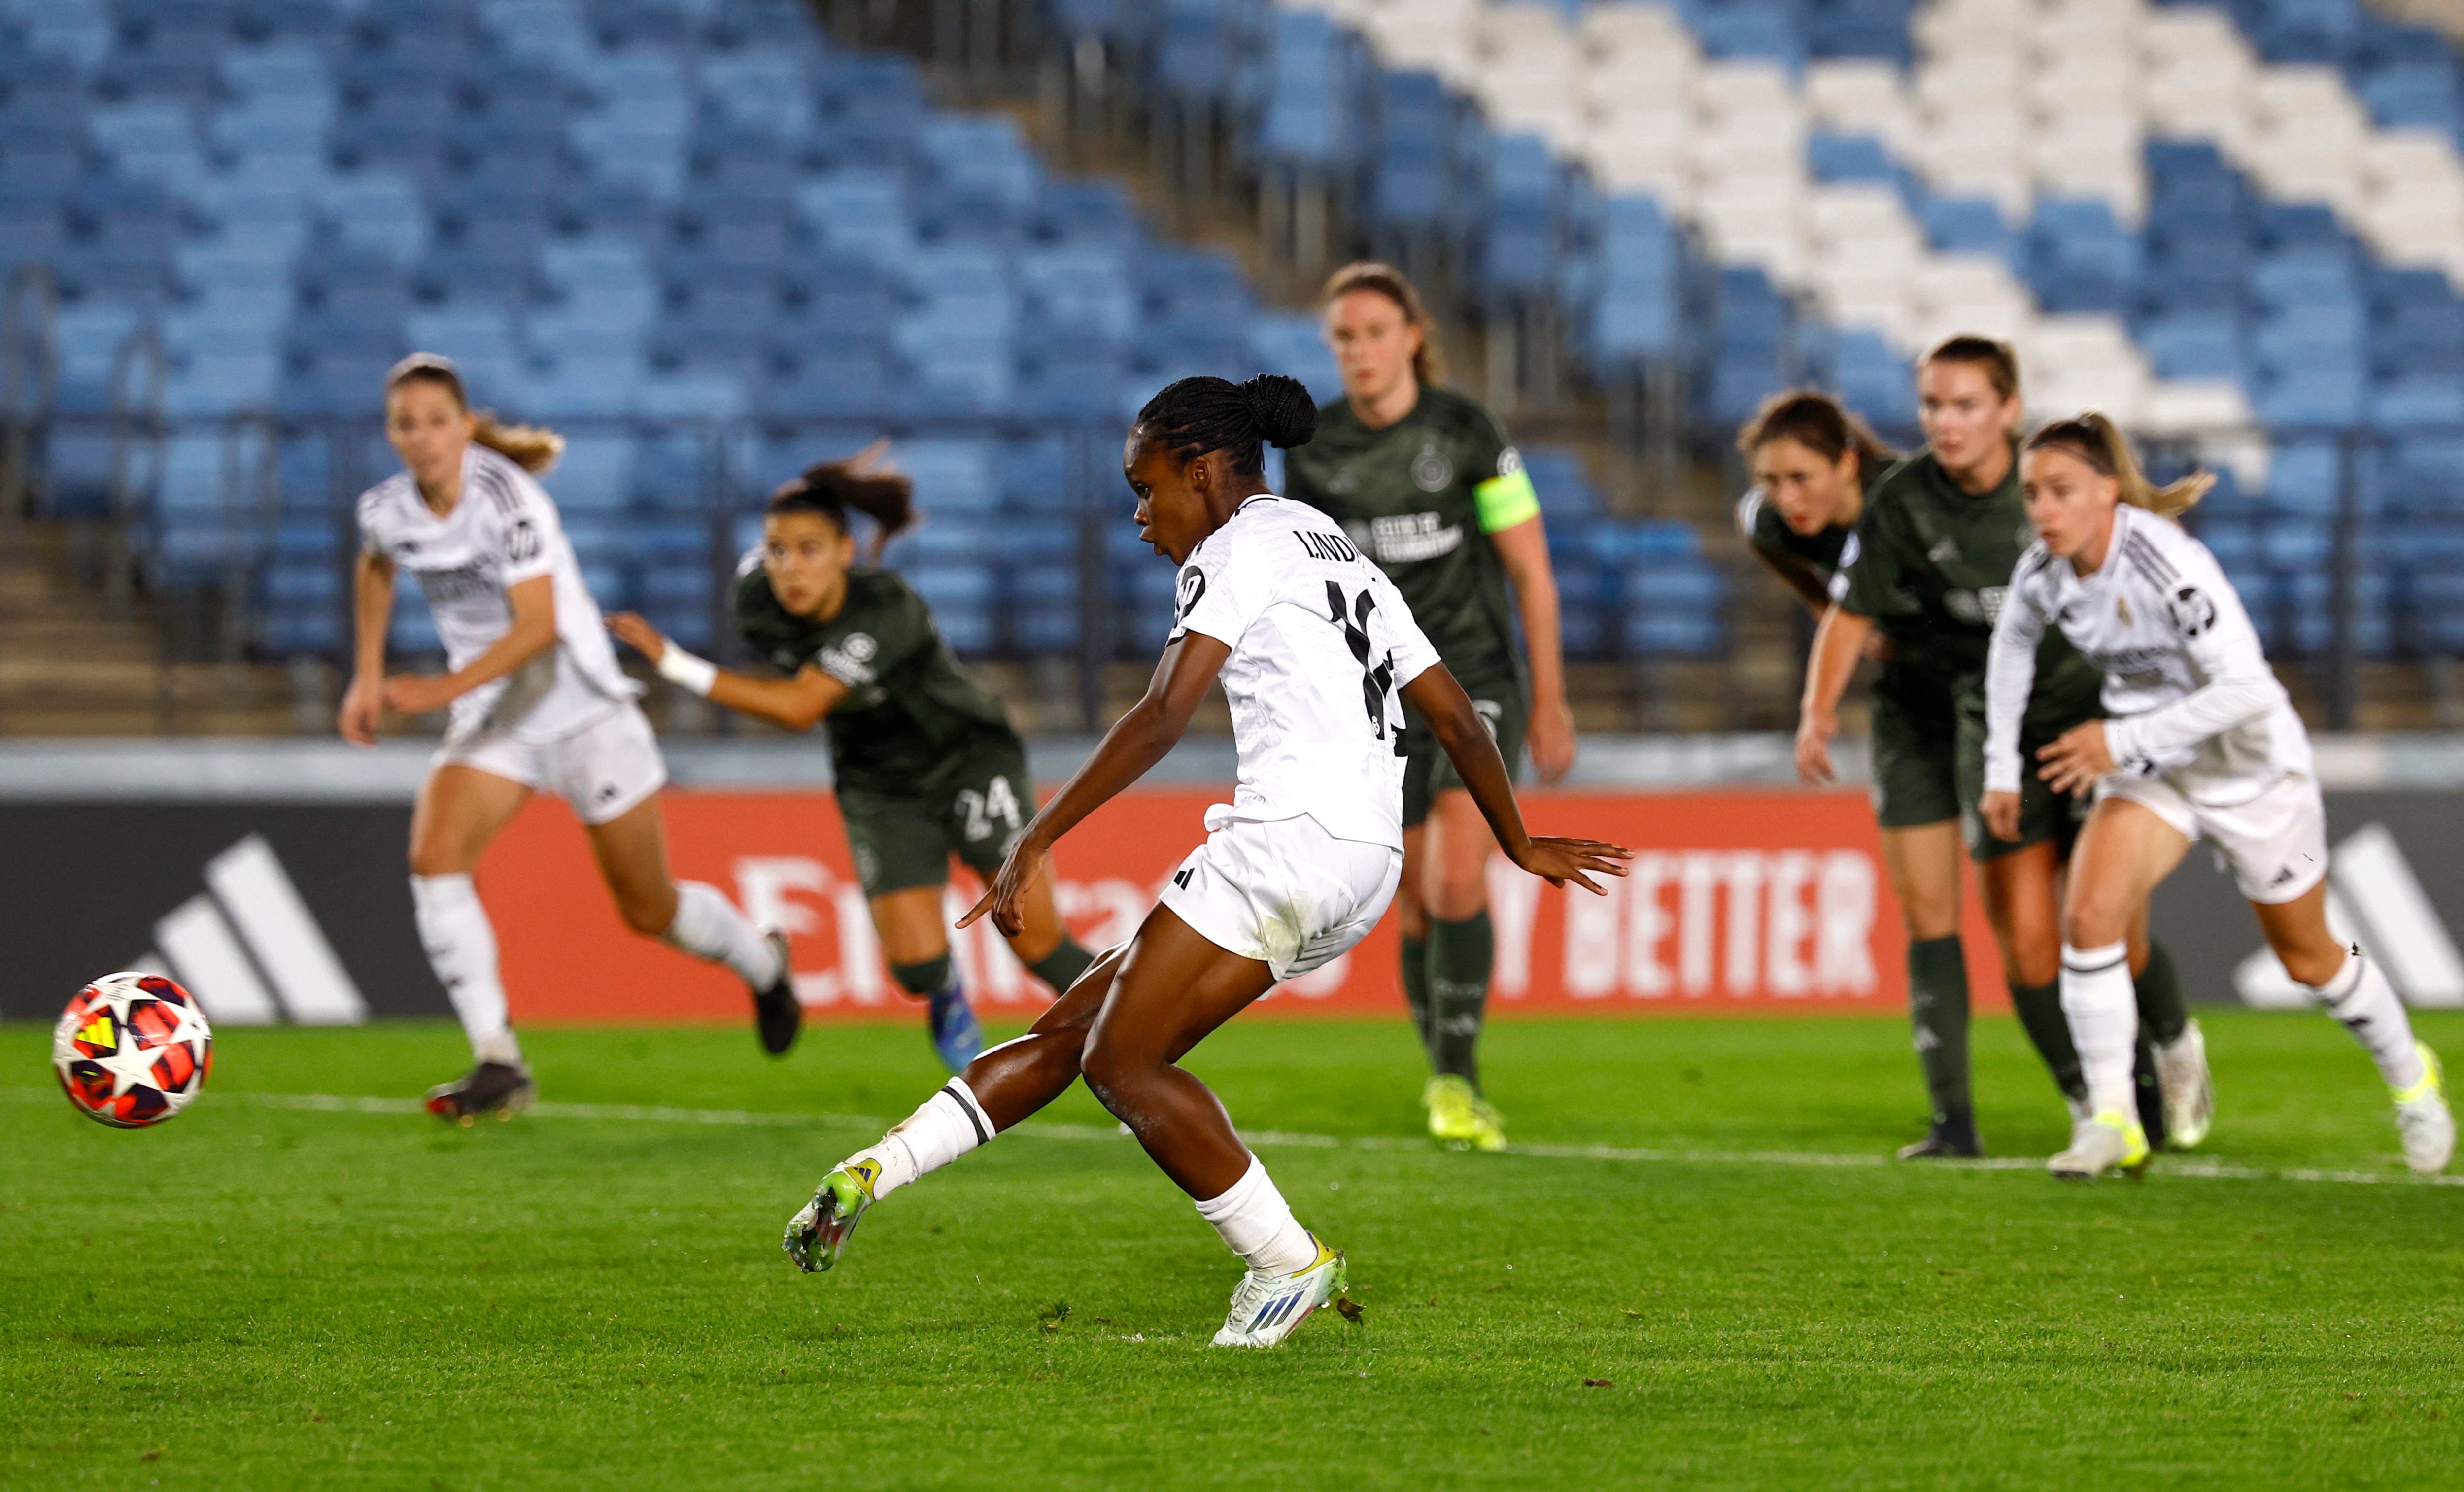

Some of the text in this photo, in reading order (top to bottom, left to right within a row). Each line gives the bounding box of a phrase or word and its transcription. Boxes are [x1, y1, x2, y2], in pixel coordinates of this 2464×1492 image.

[1292, 530, 1361, 564] LIND
[955, 775, 1020, 841] 24
[1564, 849, 1878, 998] BETTER
[1268, 1277, 1314, 1300] F50
